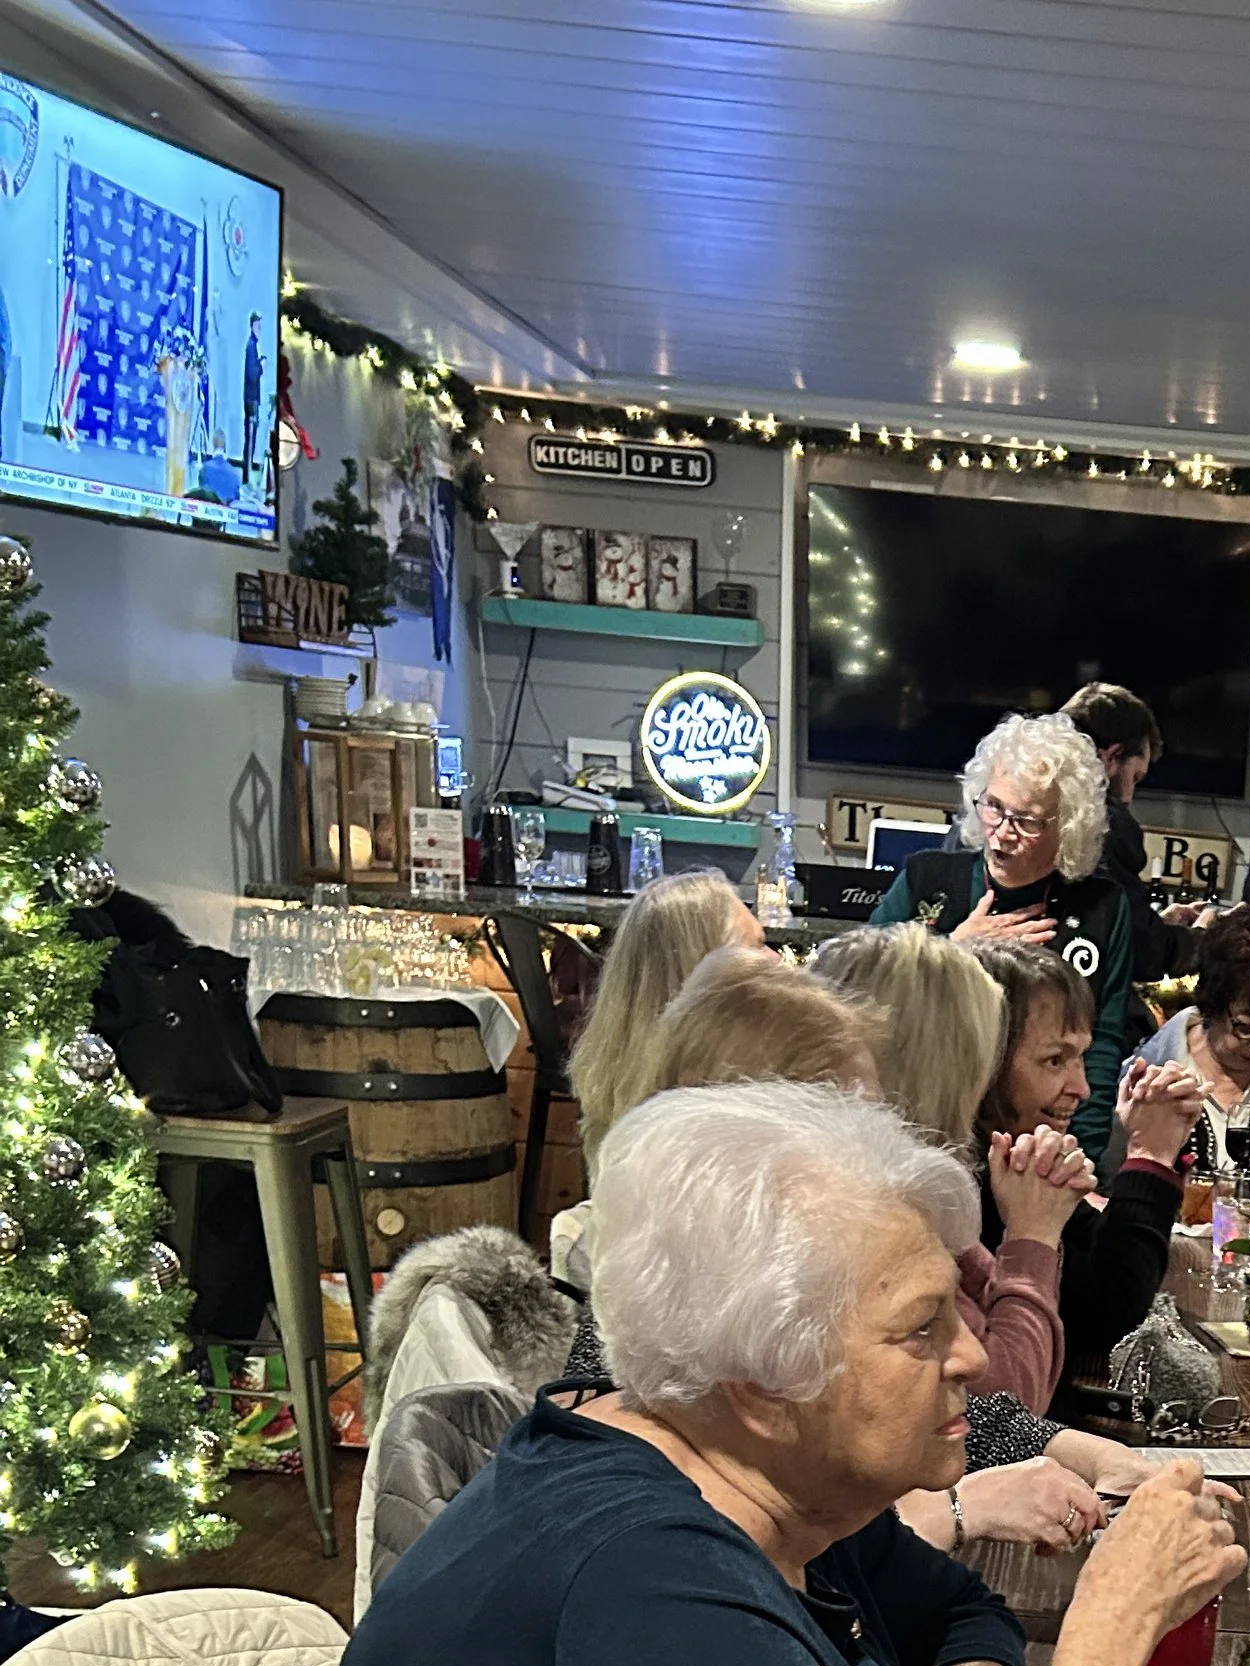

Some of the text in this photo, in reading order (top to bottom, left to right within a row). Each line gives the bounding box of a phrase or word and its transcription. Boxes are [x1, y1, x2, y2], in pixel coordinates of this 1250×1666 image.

[535, 445, 702, 477] KITCHEN OPEN
[648, 701, 765, 758] Smoky
[841, 887, 883, 905] Tito's
